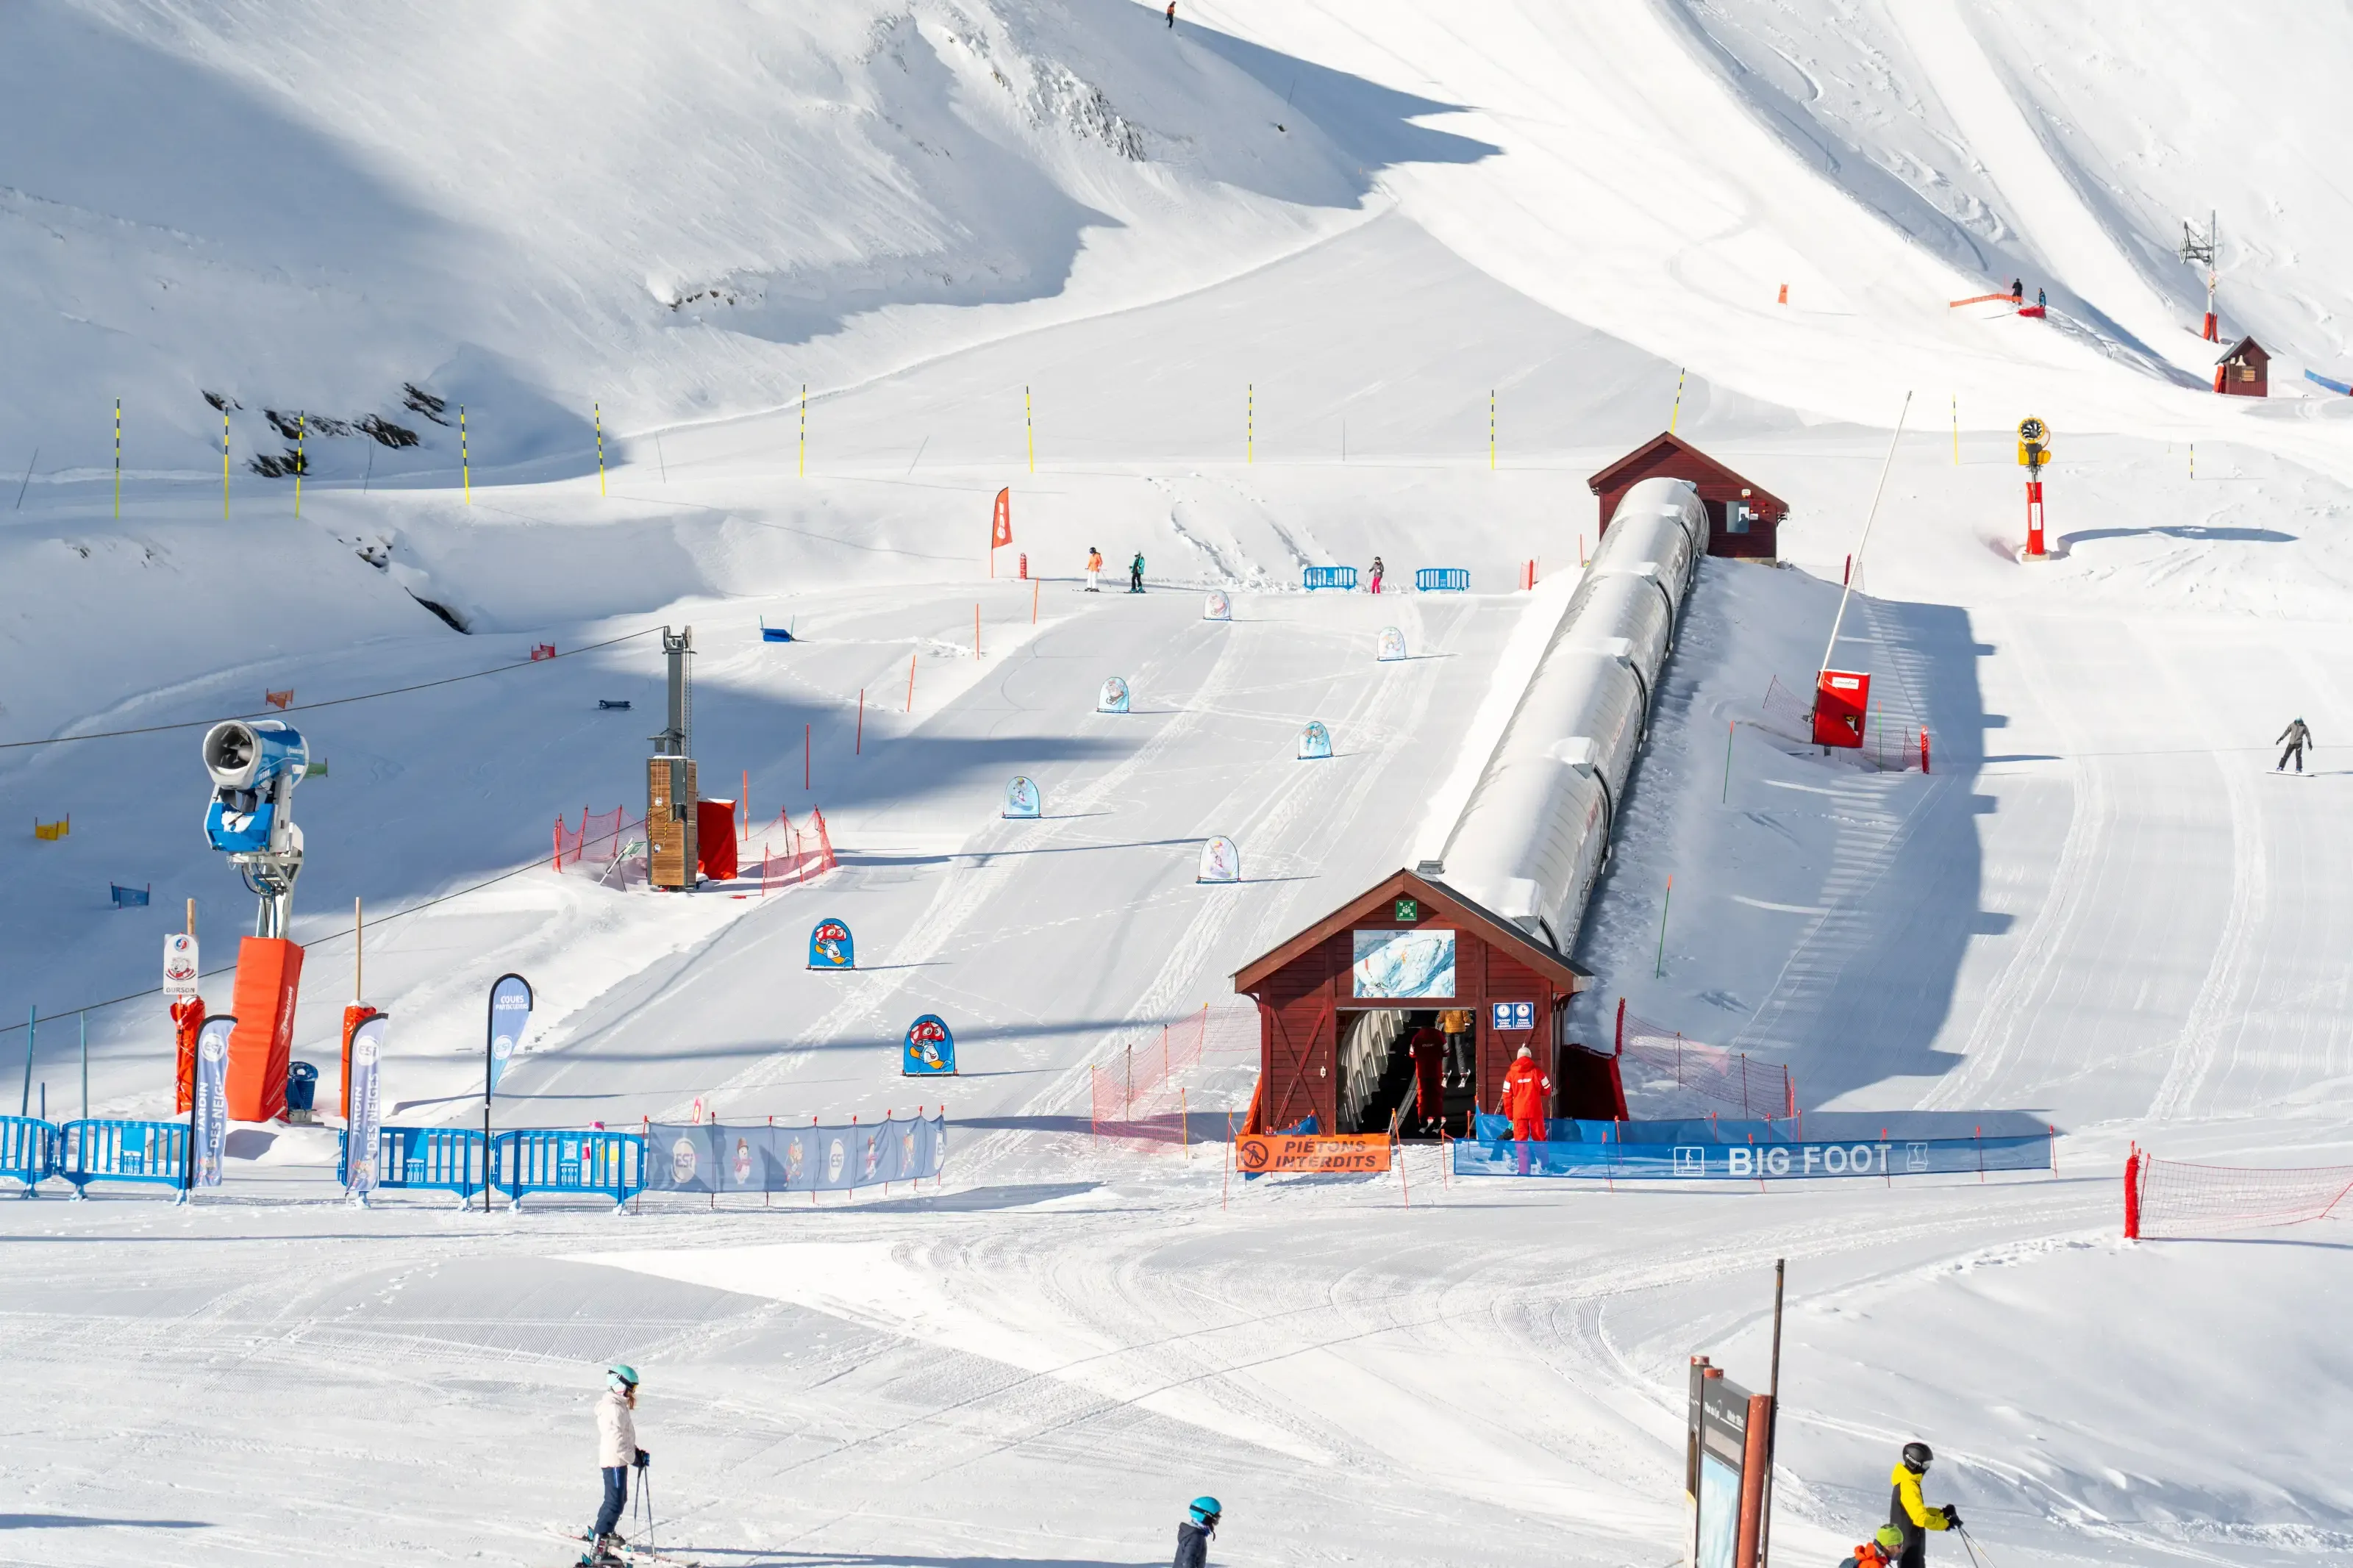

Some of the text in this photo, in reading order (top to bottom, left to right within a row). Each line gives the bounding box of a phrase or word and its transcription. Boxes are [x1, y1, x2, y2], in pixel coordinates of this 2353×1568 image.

[500, 995, 524, 1003] COURS
[198, 1081, 208, 1133] JARDIN
[353, 1086, 363, 1136] JARDIN
[366, 1073, 379, 1151] DES NEIGES
[210, 1123, 221, 1148] DES
[1285, 1138, 1366, 1153] PIÉTONS
[1276, 1156, 1376, 1167] INTERDITS
[1729, 1144, 1892, 1176] BIG FOOT
